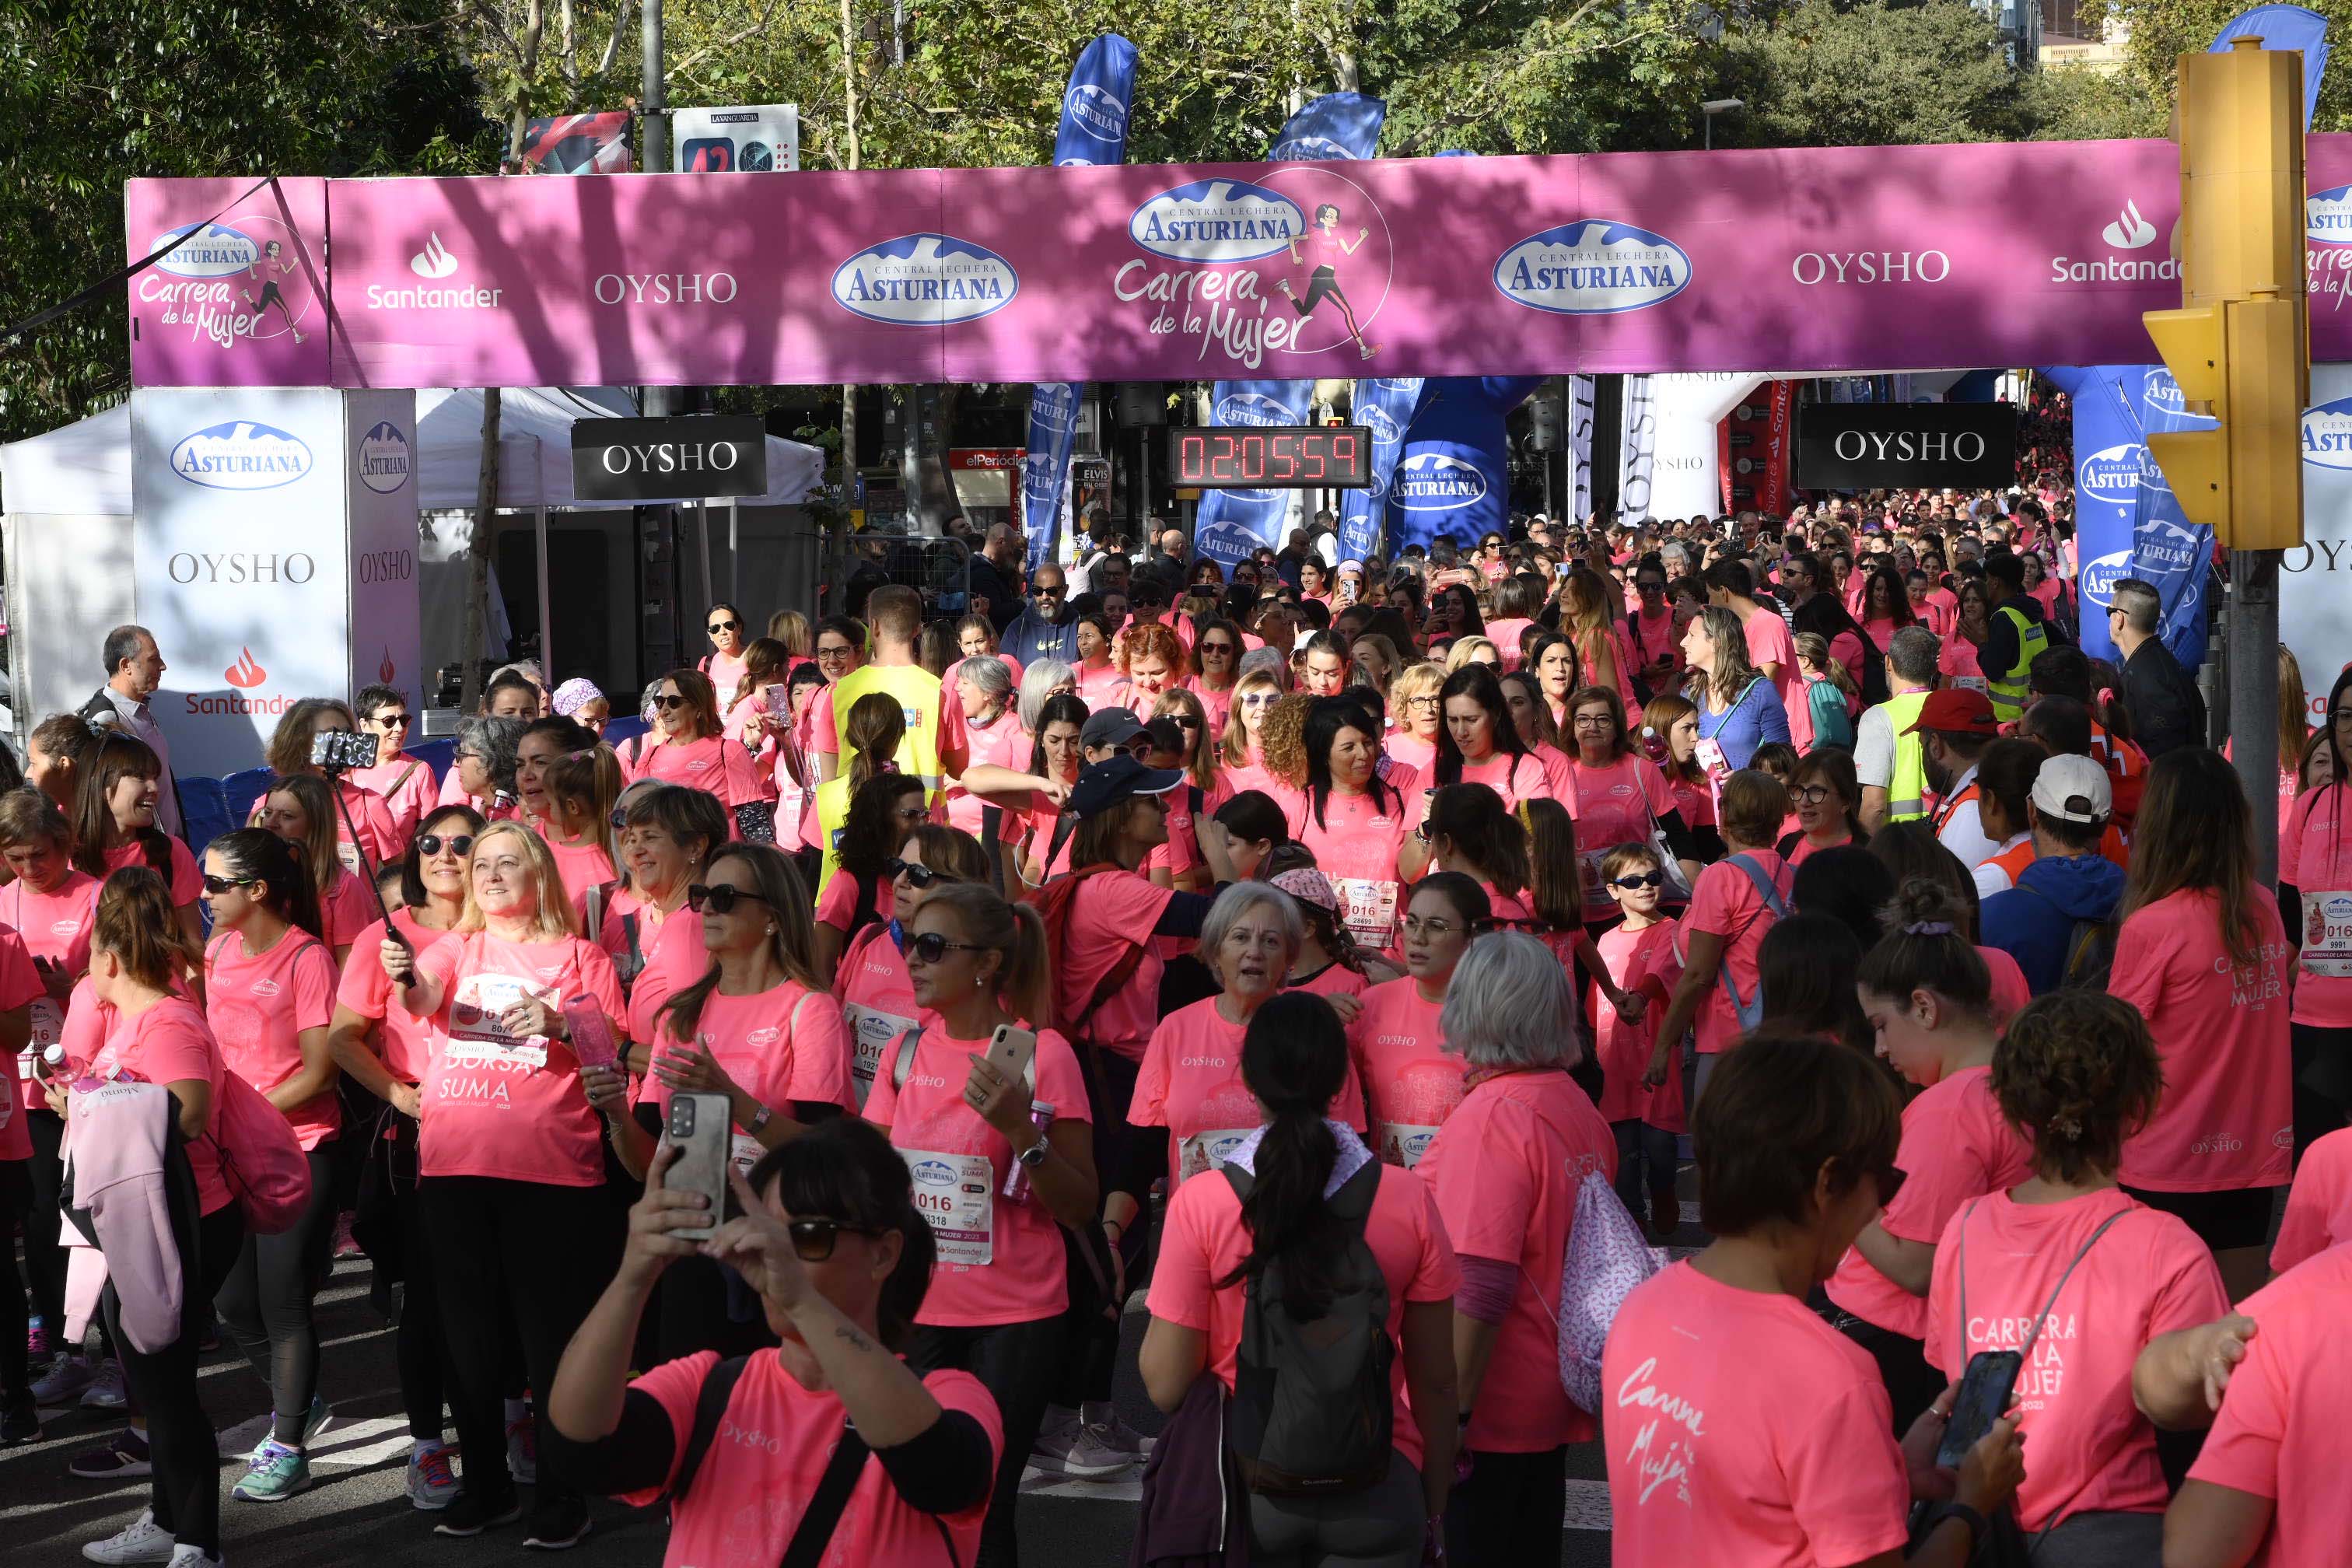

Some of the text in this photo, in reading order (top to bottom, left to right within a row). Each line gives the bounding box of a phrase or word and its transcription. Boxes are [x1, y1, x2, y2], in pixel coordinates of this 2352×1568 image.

[1169, 206, 1287, 217] CENTRAL LECHERA
[1143, 210, 1293, 243] ASTURIANA
[1539, 250, 1670, 263] CENTRAL LECHERA
[1792, 249, 1951, 285] OYSHO
[874, 264, 997, 275] CENTRAL LECHERA
[1508, 255, 1677, 291] ASTURIANA
[138, 274, 231, 303] Carrera
[593, 271, 738, 305] OYSHO
[846, 267, 1003, 302] ASTURIANA
[1114, 258, 1259, 303] Carrera
[367, 284, 502, 310] Santander
[161, 299, 266, 348] de la Mujer
[1149, 296, 1314, 369] de la Mujer
[1181, 436, 1355, 478] 02:05:59
[1835, 429, 1986, 464] OYSHO
[181, 446, 303, 473] ASTURIANA
[362, 450, 408, 476] ASTURIANA
[602, 440, 738, 475] OYSHO
[1653, 457, 1703, 471] YSHO
[1083, 469, 1108, 479] ELVIS
[1391, 478, 1479, 498] ASTURIANA
[168, 552, 315, 584] OYSHO
[359, 548, 412, 585] OYSHO
[186, 693, 296, 716] Santande
[2280, 774, 2293, 786] DE
[1352, 905, 1376, 916] 016
[1353, 917, 1372, 926] 28699
[863, 961, 893, 976] YSHO
[2231, 980, 2282, 1008] MUJER
[32, 1029, 49, 1041] 16
[459, 1032, 487, 1042] CARRERA
[491, 1024, 509, 1034] 807
[862, 1023, 892, 1037] ASTURIANA
[1377, 1034, 1416, 1047] OYSHO
[444, 1056, 538, 1079] DORSA
[1181, 1056, 1226, 1068] OYSHO
[438, 1077, 511, 1102] SUMA
[2192, 1139, 2242, 1155] OYSHO
[914, 1167, 956, 1184] ASTURIANA
[918, 1192, 952, 1212] 016
[940, 1230, 962, 1239] MUJER
[945, 1244, 983, 1257] Santander
[2032, 1342, 2063, 1367] LA
[2021, 1400, 2045, 1411] 2023
